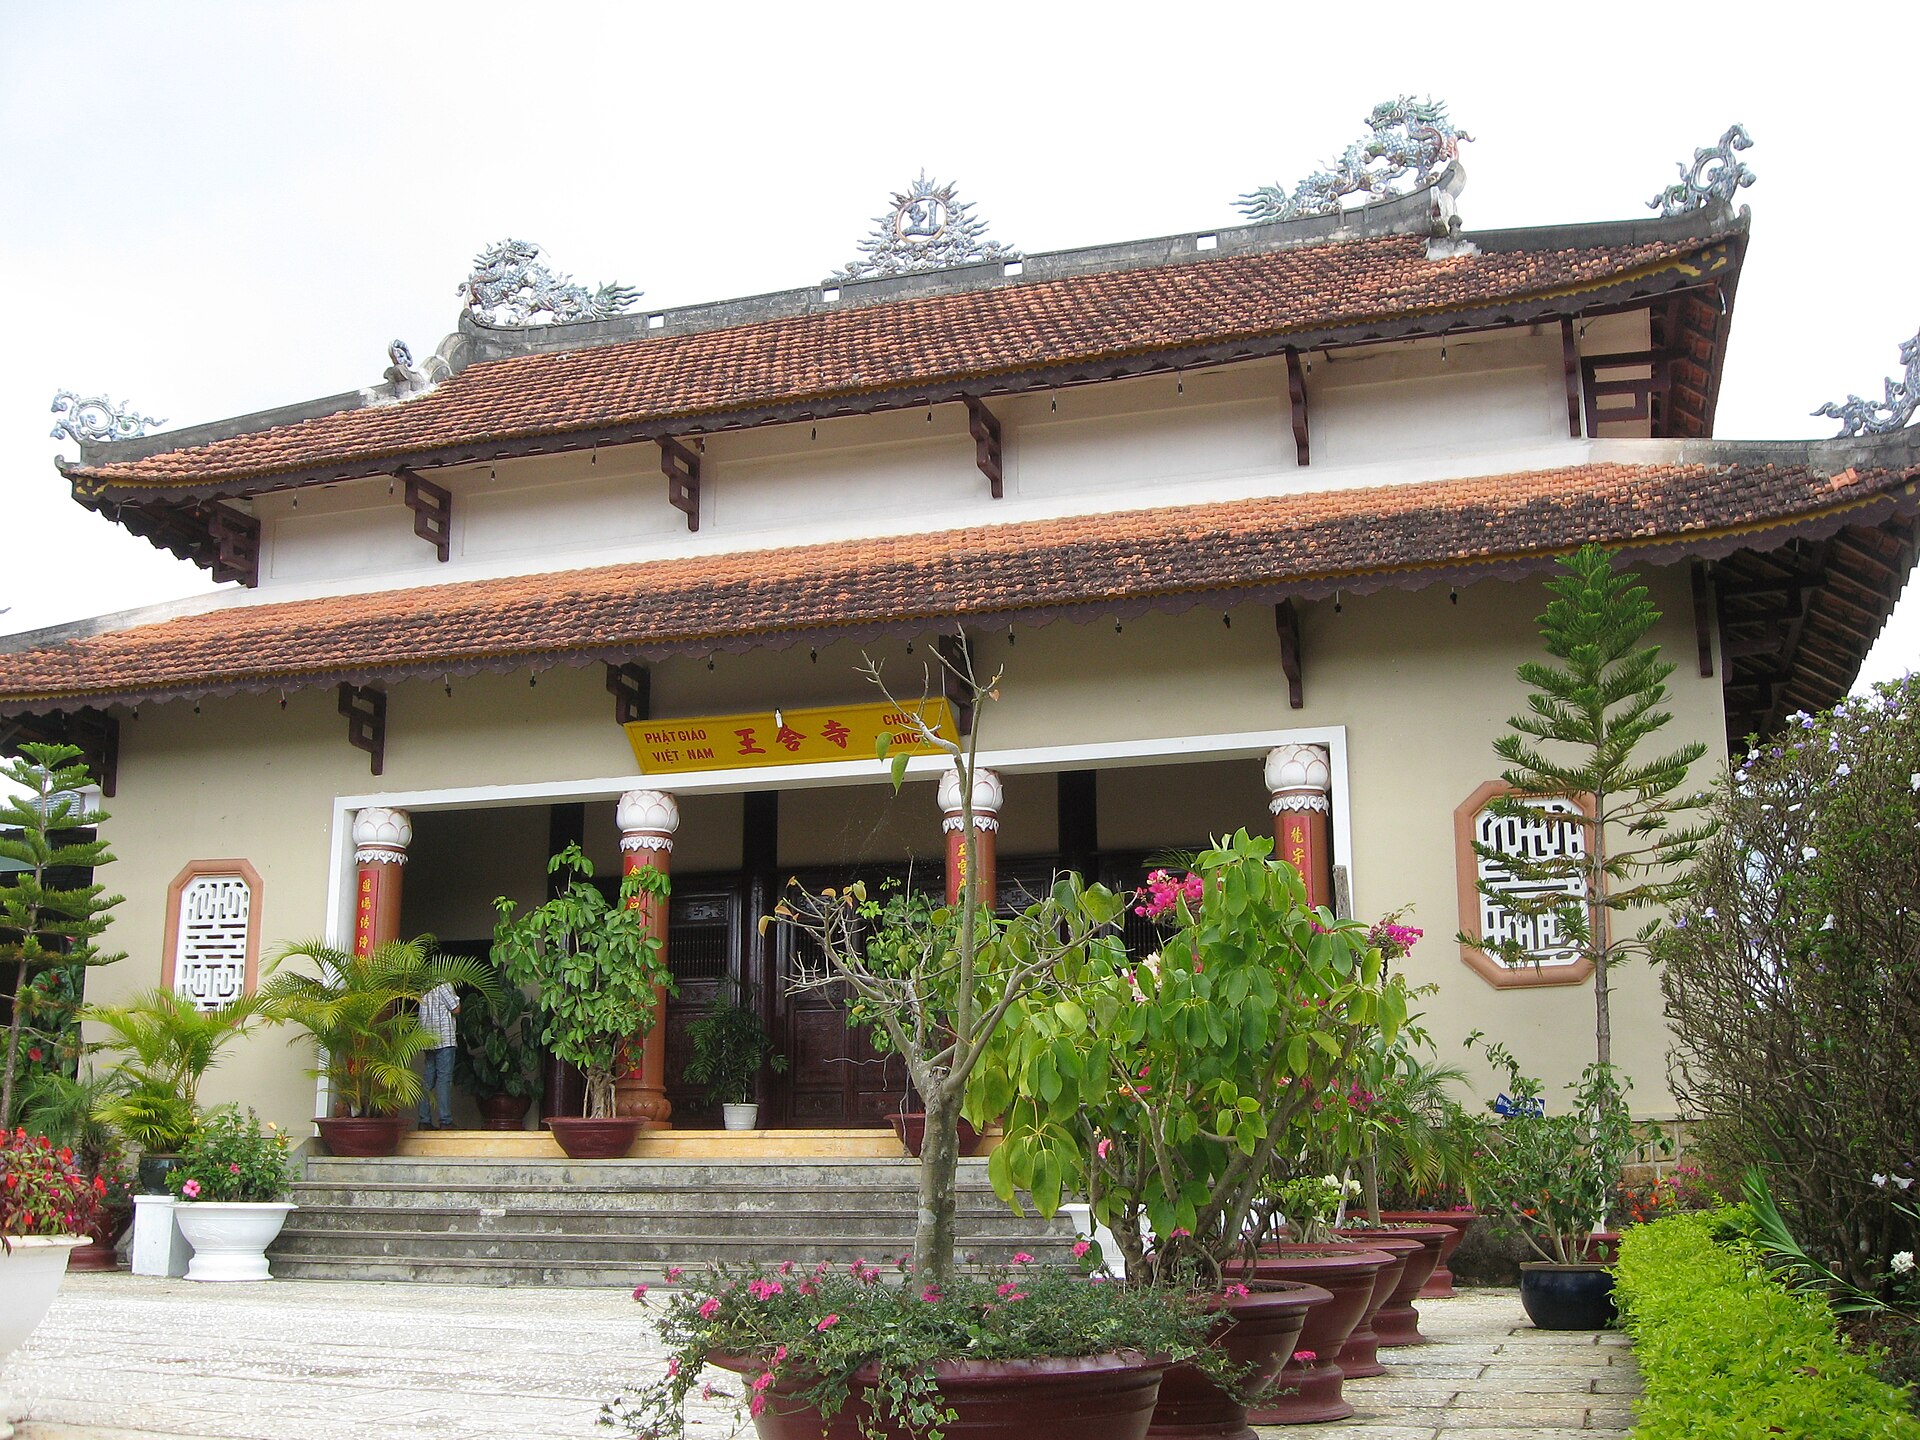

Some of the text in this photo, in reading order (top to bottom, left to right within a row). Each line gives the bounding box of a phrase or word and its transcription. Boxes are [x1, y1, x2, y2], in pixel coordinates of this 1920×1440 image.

[644, 727, 707, 745] PHẬT GIÁO
[652, 748, 680, 764] VIỆT
[686, 748, 715, 760] NAM
